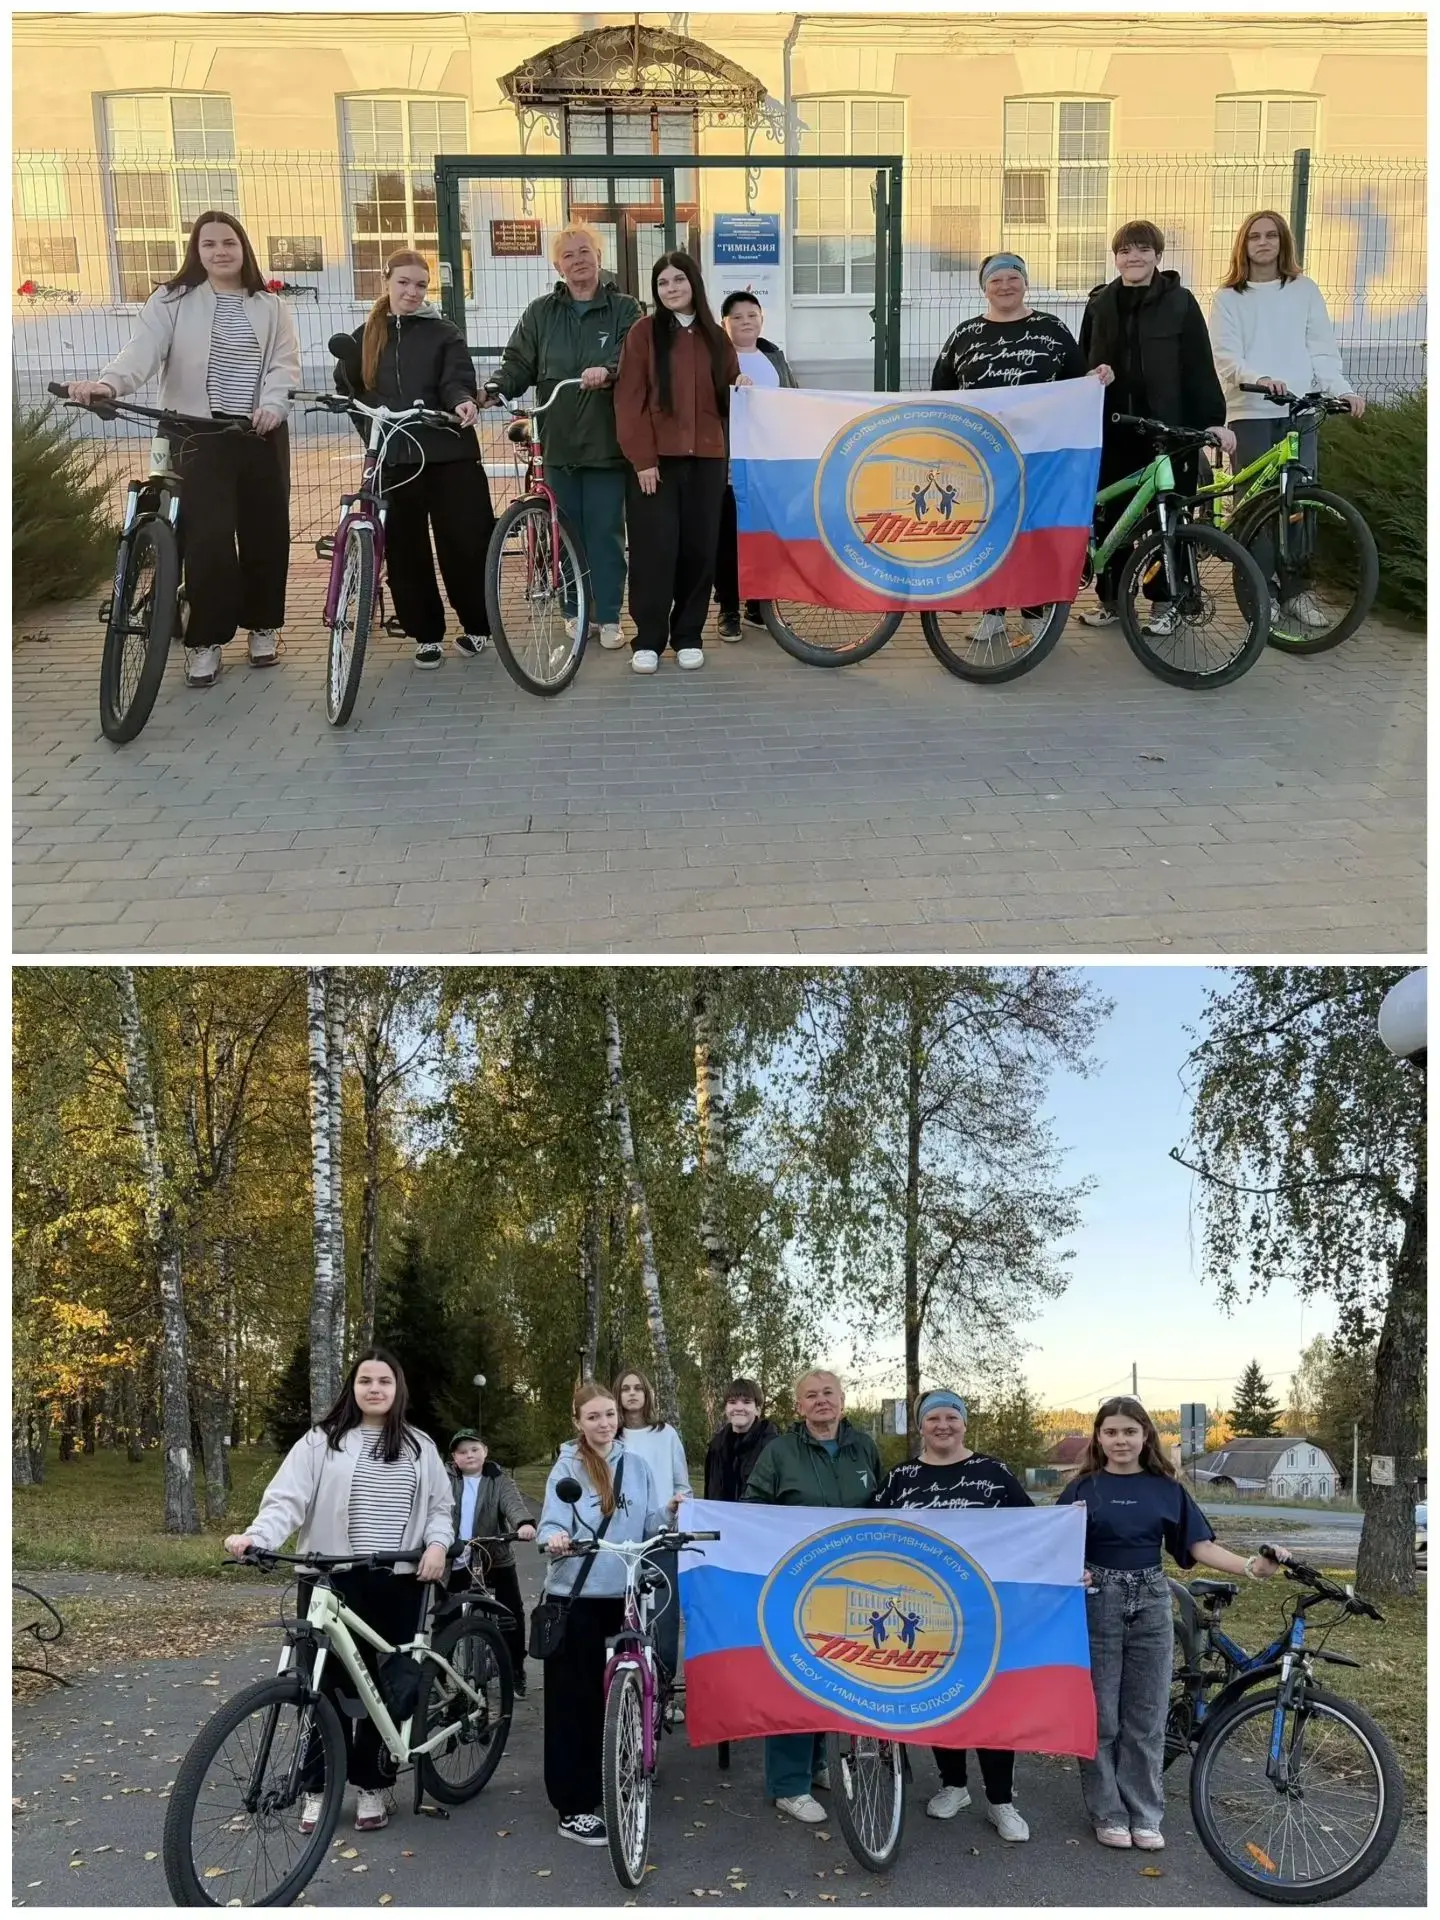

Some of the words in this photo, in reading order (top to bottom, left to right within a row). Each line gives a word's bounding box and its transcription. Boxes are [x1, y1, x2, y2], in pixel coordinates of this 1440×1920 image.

[1015, 330, 1063, 351] happy
[989, 347, 1050, 366] happy
[977, 362, 1038, 387] happy
[840, 413, 902, 456] ШКОЛЬНЫЙ
[903, 411, 983, 433] СПОРТИВНЫЙ
[981, 428, 1003, 453] КЛУБ
[843, 543, 872, 570] МБОУ
[950, 1475, 1006, 1498] happy
[788, 1534, 853, 1576] ШКОЛЬНЫЙ
[855, 1531, 943, 1558] СПОРТИВНЫЙ
[943, 1554, 970, 1581] КЛУБ
[789, 1652, 823, 1682] МБОУ
